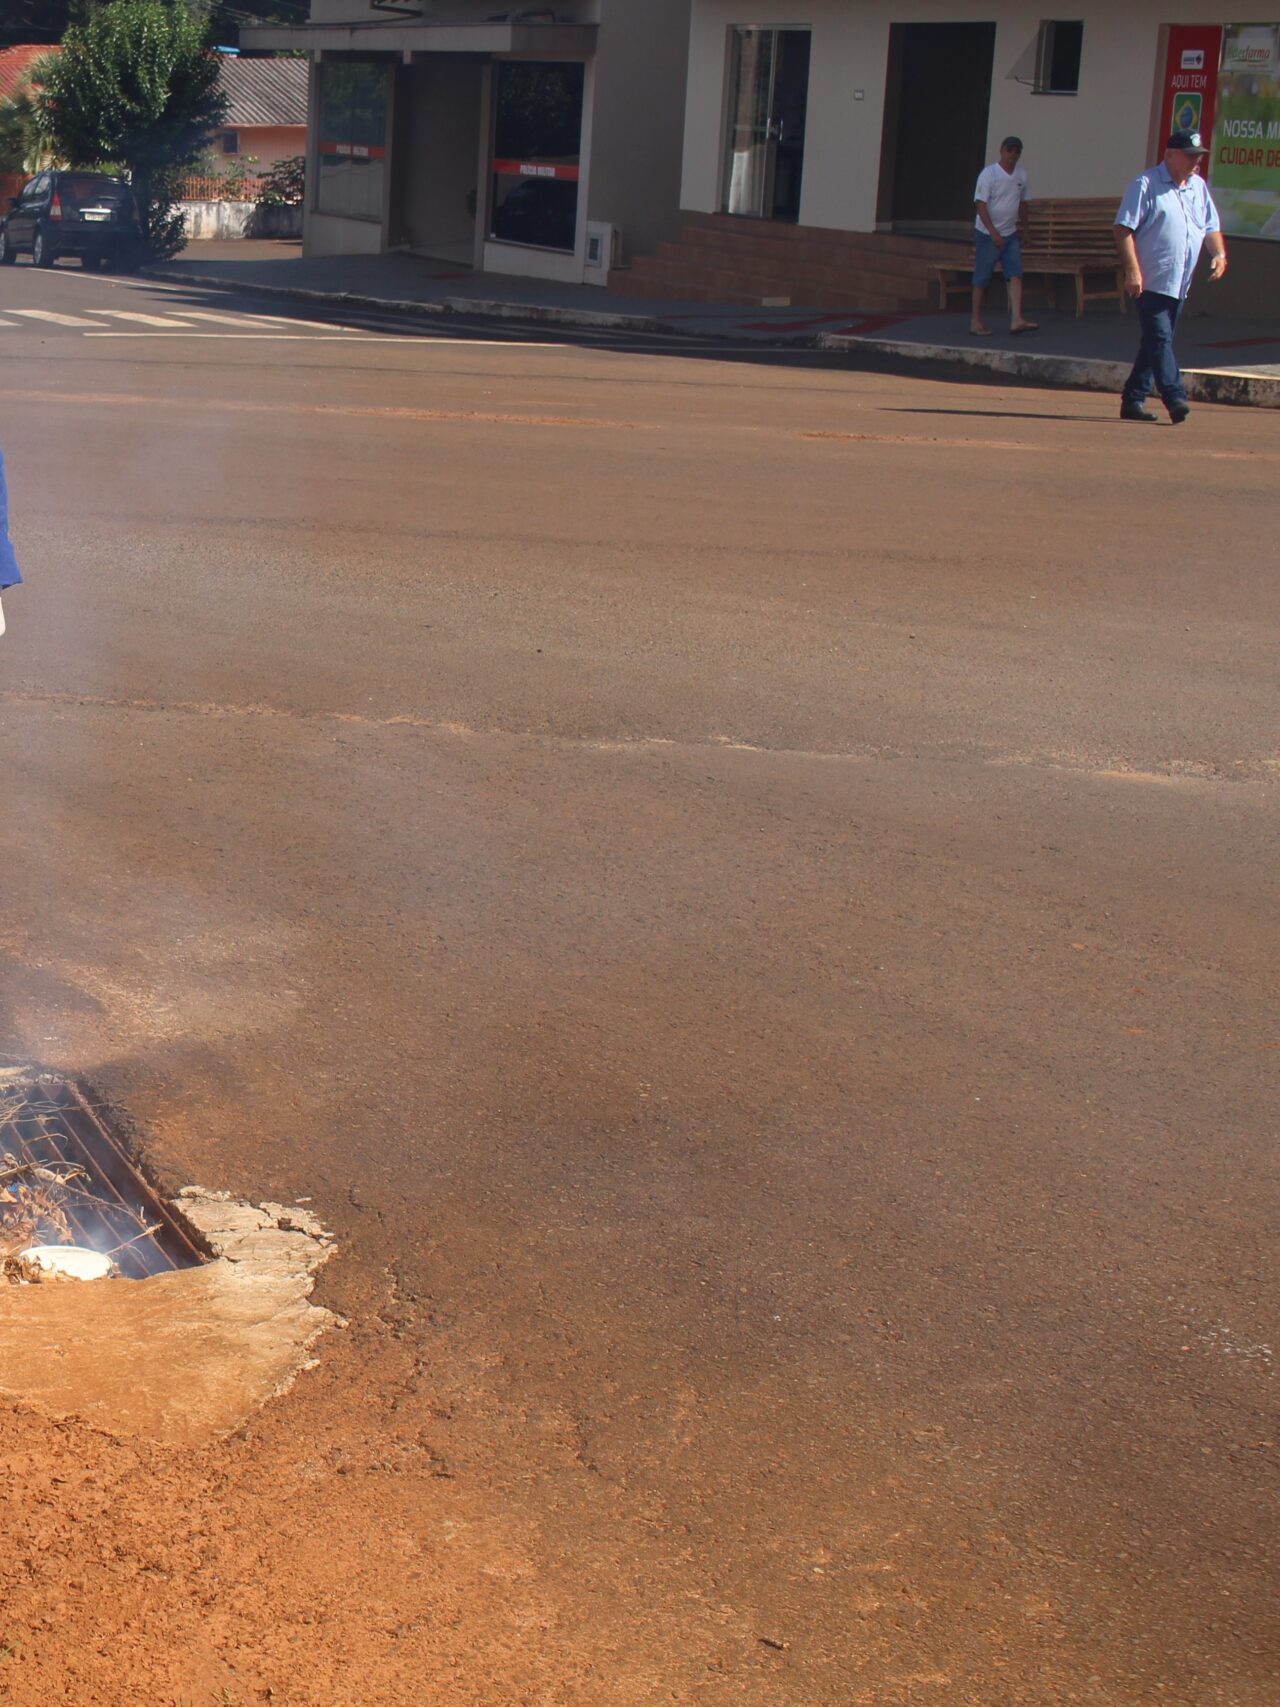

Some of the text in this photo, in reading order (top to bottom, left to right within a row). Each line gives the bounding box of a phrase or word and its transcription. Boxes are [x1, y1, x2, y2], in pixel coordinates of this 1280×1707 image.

[1171, 75, 1207, 88] AQUI TEM
[1223, 119, 1263, 139] NOSSA
[1220, 146, 1265, 166] CUIDAR
